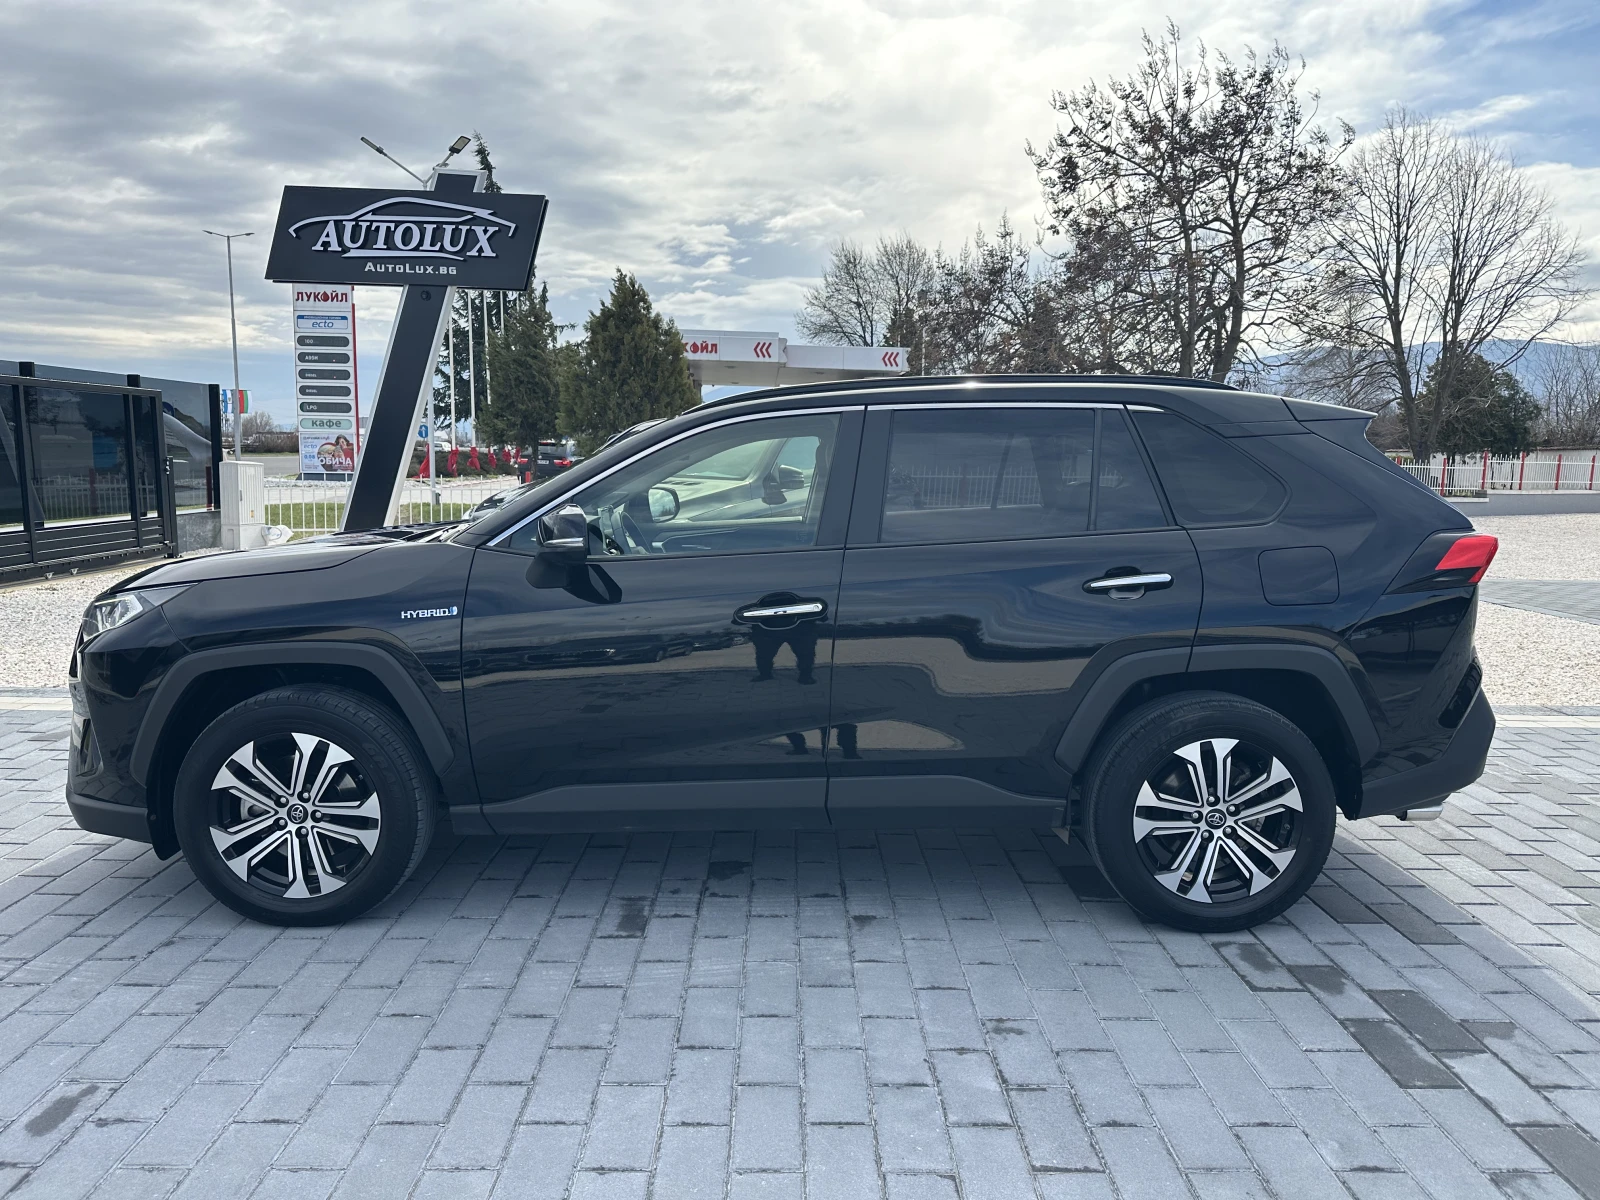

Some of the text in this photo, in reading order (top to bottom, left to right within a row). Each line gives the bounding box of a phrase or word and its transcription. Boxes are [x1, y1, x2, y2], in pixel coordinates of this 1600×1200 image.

[311, 220, 498, 257] AUTOLUX
[295, 290, 348, 302] ЛУКОЙЛ
[312, 320, 334, 328] ecto
[683, 341, 718, 354] КОЙЛ
[318, 457, 353, 465] ОБИЧА
[401, 608, 449, 619] HYBRID
